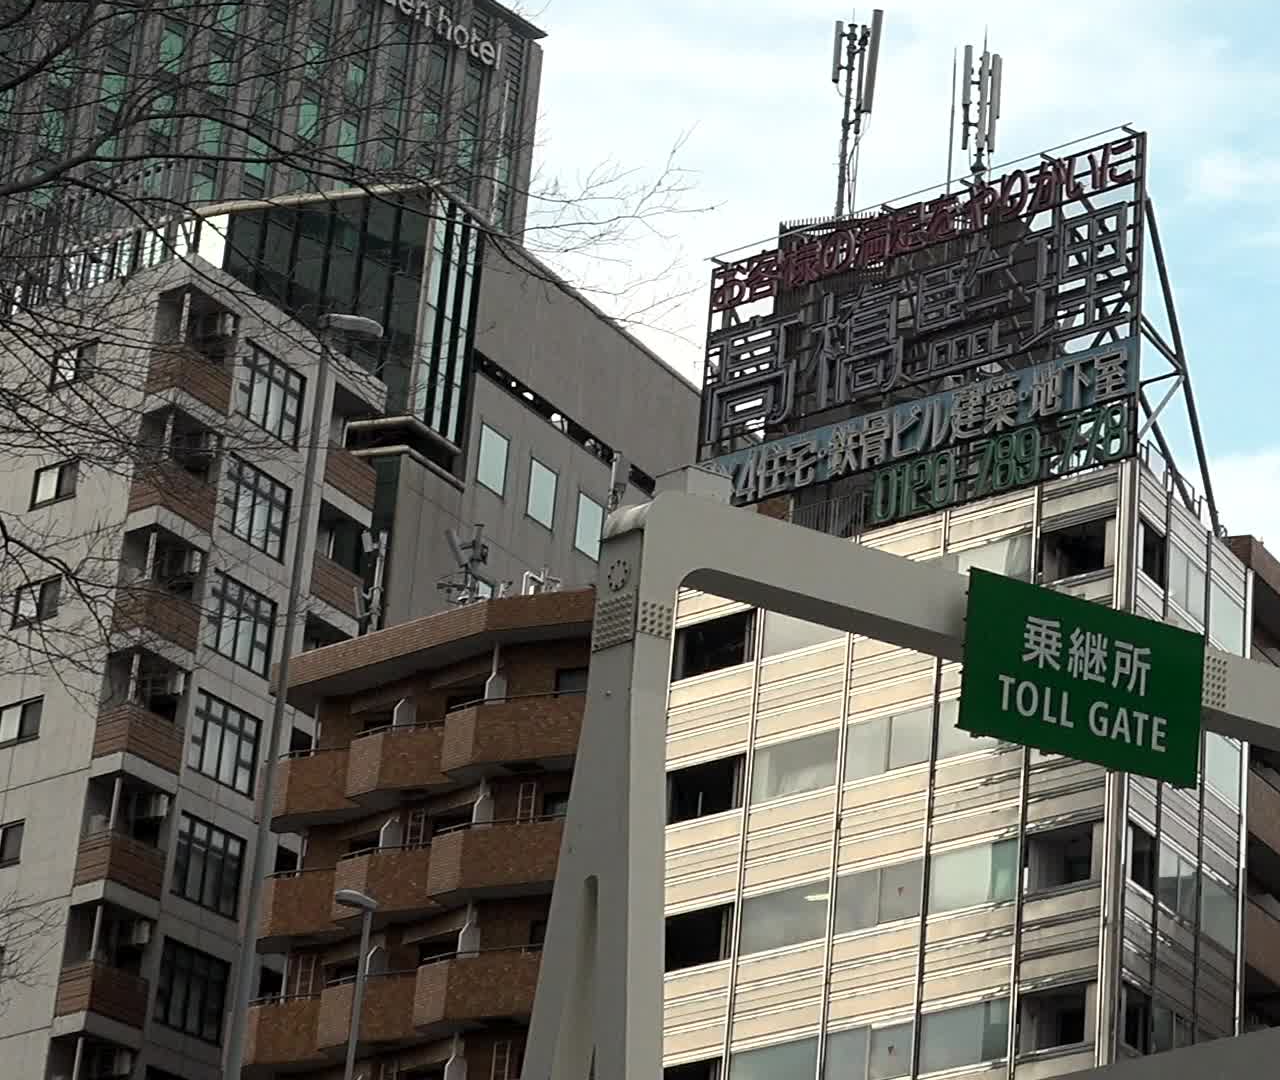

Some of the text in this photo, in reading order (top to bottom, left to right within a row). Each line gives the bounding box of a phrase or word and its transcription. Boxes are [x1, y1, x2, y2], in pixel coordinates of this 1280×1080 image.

[436, 5, 504, 71] hotel
[874, 401, 1128, 521] 0120-789-778
[1022, 615, 1152, 697] 乗継所
[998, 674, 1168, 753] TOLL GATE
